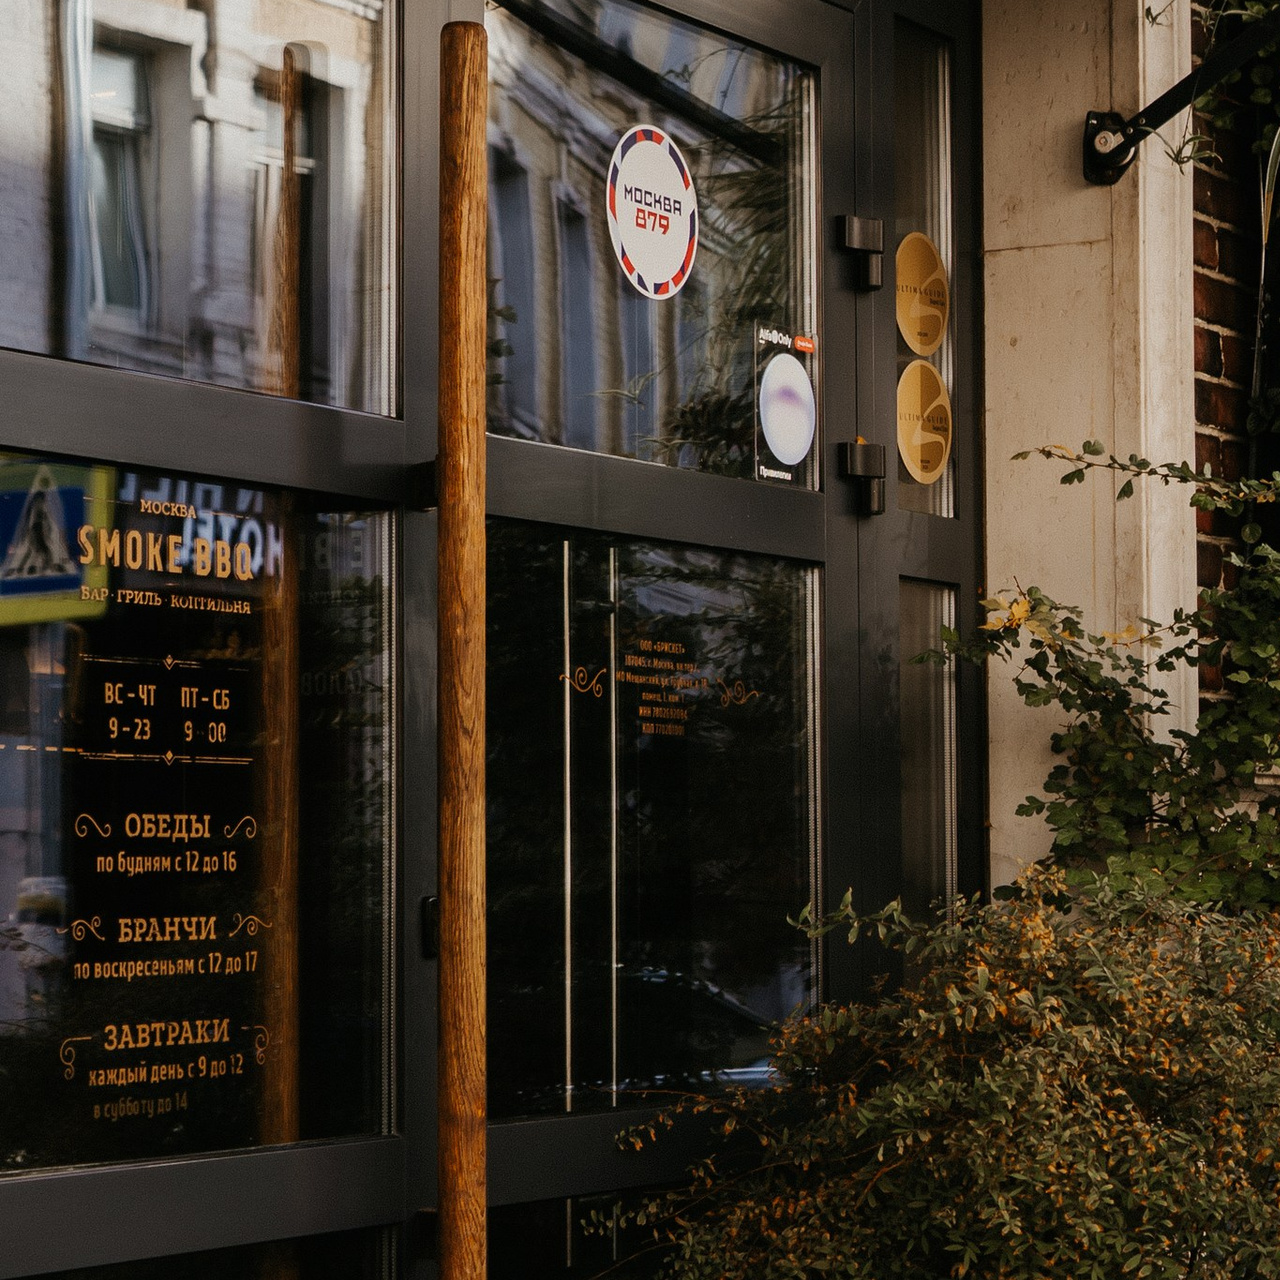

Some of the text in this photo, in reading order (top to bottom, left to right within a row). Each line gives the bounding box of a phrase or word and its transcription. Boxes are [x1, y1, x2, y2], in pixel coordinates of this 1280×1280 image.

[624, 184, 682, 216] МОСКВА
[635, 207, 670, 235] 879
[140, 499, 197, 519] МОСКВА
[77, 524, 183, 574] SMOKE
[193, 537, 254, 581] BBQ
[80, 585, 109, 601] БАР
[116, 589, 163, 607] ГРИЛЬ
[124, 812, 211, 843] ОБЕДЫ
[96, 850, 237, 878] по будням с 12 до 16
[117, 916, 217, 943] БРАНЧИ
[73, 950, 258, 983] по воскресеньям с 12 до 17
[103, 1018, 231, 1051] ЗАВТРАКИ
[88, 1053, 244, 1087] каждый день с 9 до 12
[103, 1097, 155, 1122] субботу
[157, 1097, 172, 1115] до
